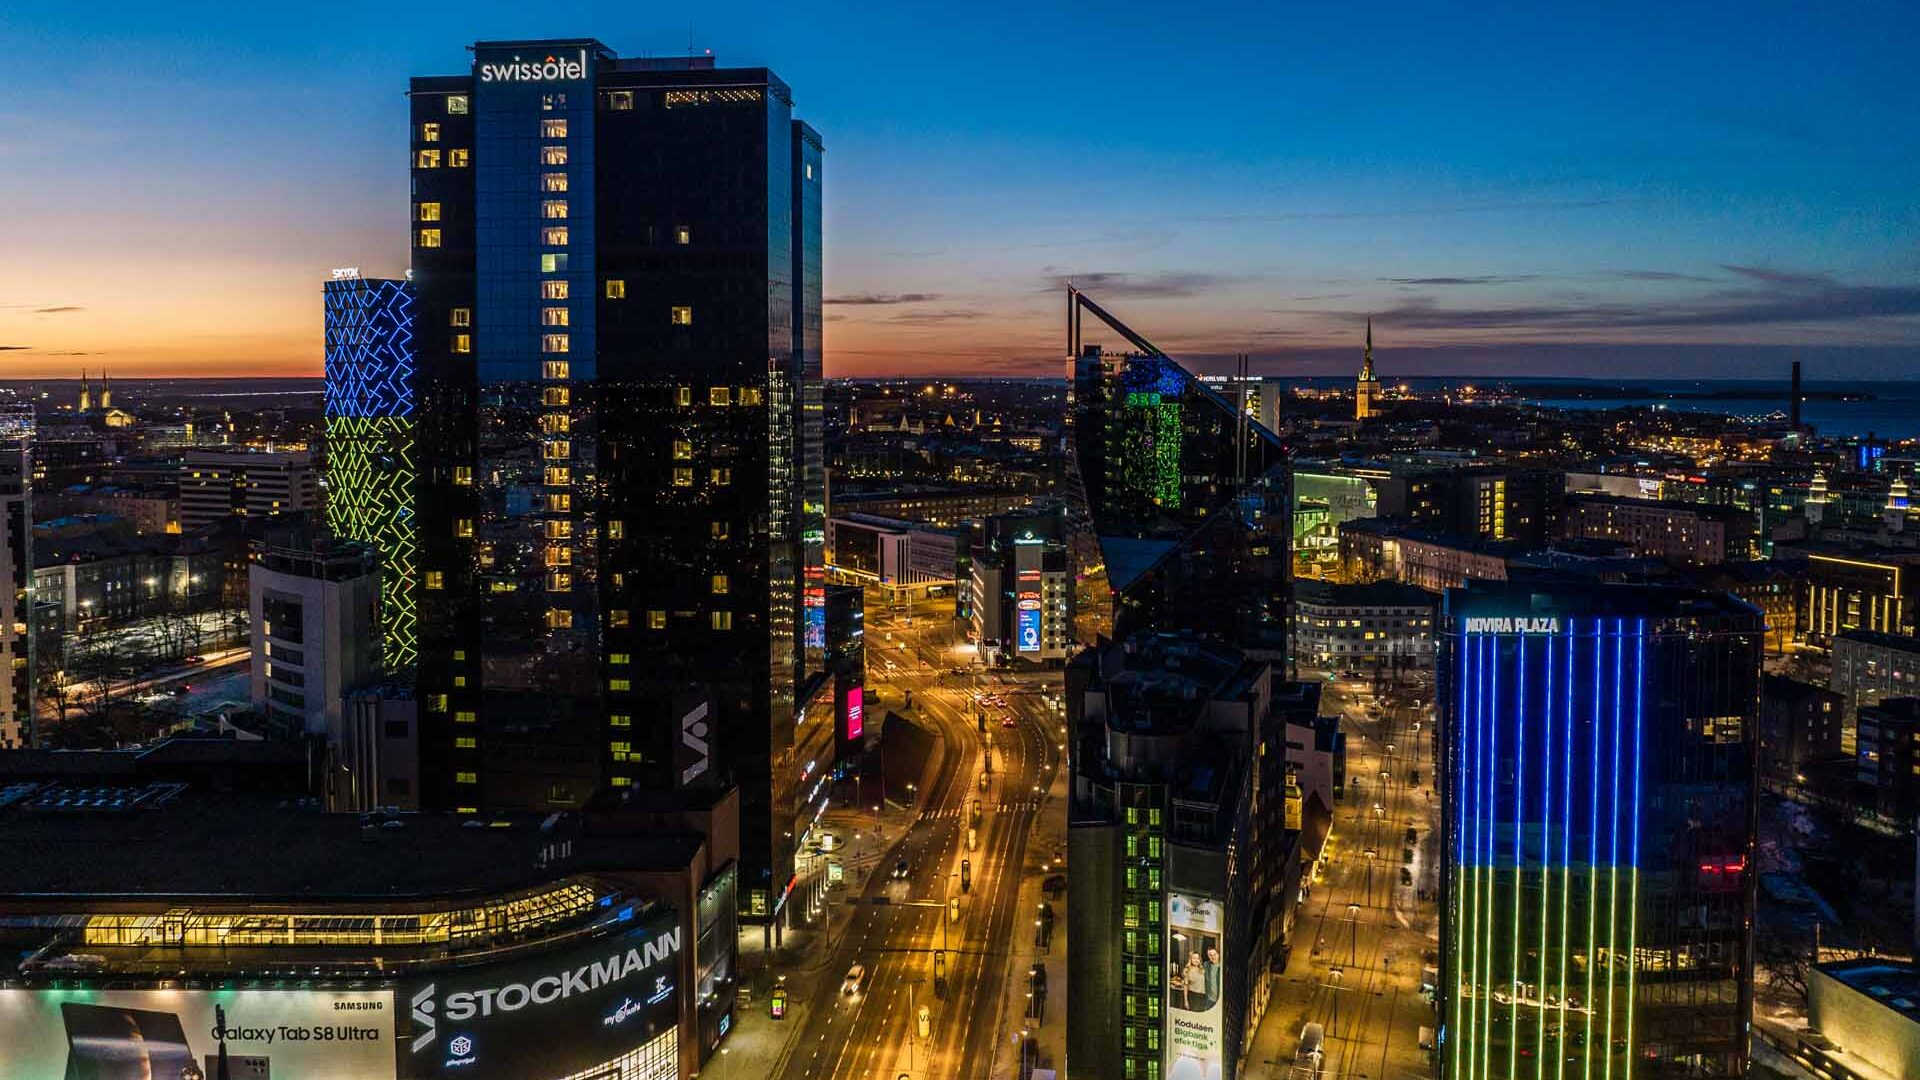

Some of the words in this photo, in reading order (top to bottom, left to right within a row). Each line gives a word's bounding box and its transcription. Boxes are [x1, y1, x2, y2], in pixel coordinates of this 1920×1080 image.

[481, 49, 586, 82] swissôtel
[1465, 617, 1513, 633] NOVIRA
[1514, 617, 1559, 633] PLAZA
[446, 926, 681, 1021] STOCKMANN
[334, 1001, 383, 1011] SAMSUNG
[211, 1026, 276, 1044] Galaxy
[278, 1026, 310, 1041] Tab
[313, 1026, 335, 1041] S8
[337, 1026, 379, 1041] Ultra
